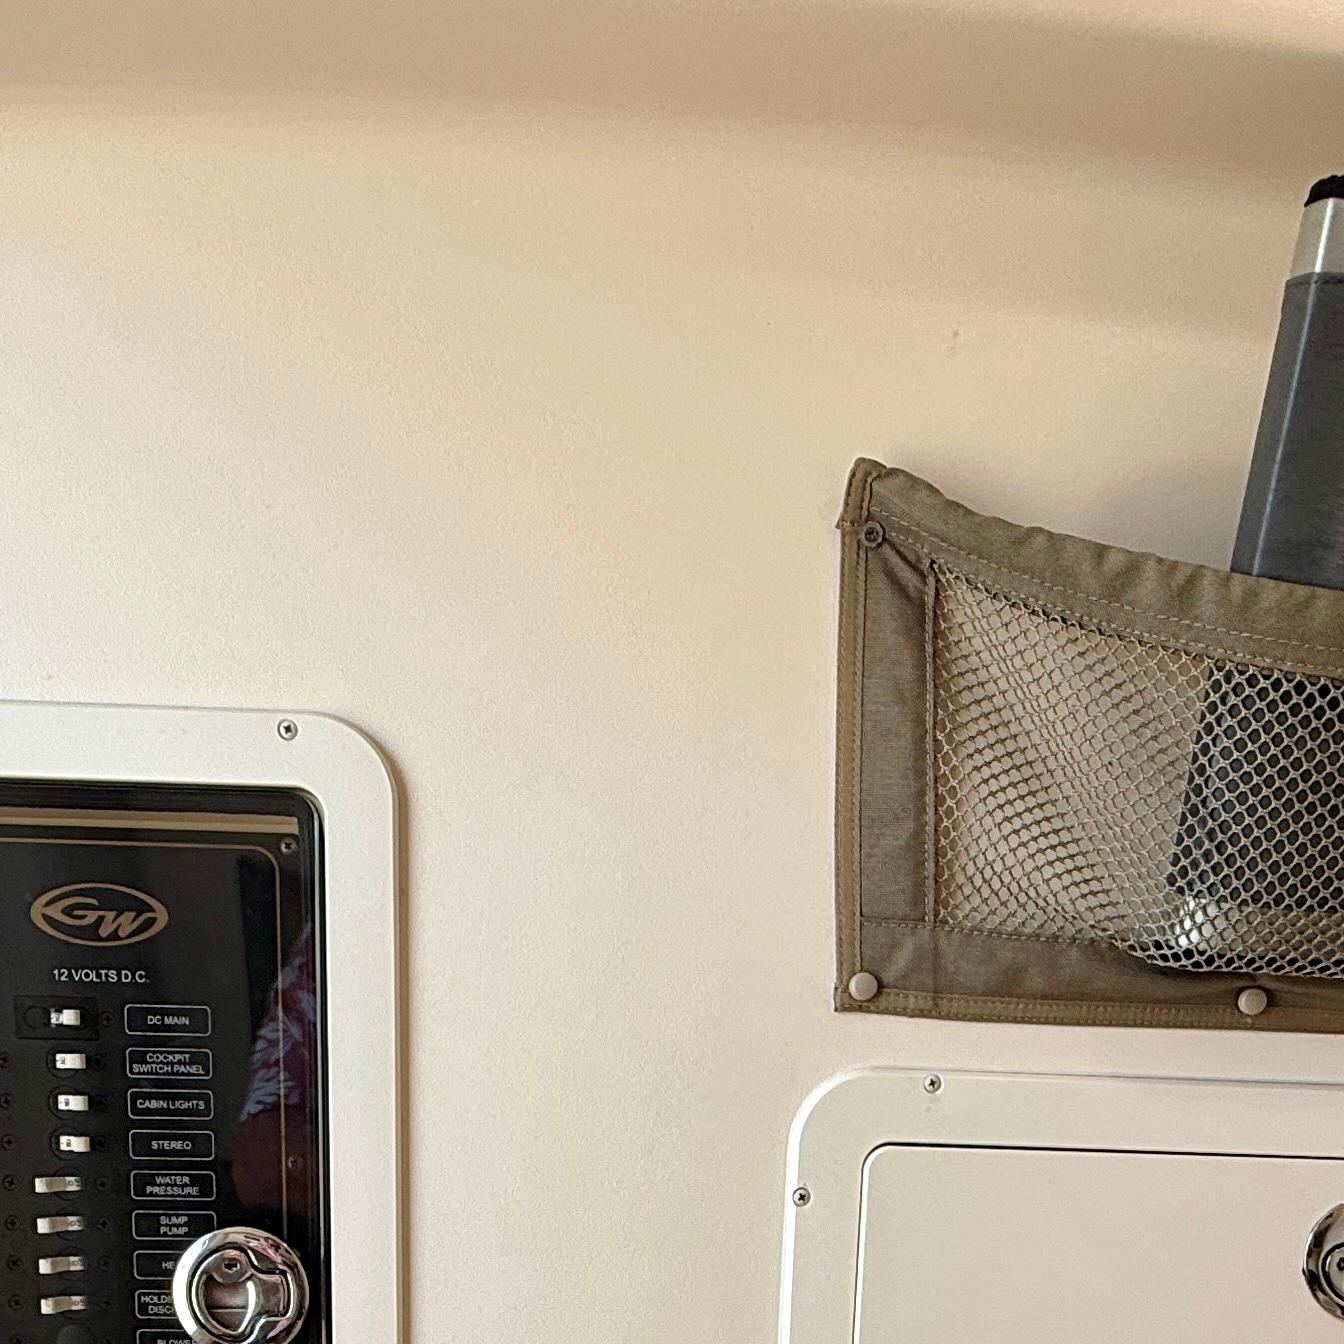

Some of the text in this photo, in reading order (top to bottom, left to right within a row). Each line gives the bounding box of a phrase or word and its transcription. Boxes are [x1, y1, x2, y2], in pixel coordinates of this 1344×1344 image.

[40, 895, 156, 938] GW
[53, 968, 150, 983] 12 VOLTS D.C.
[147, 1015, 190, 1026] DC MAIN
[146, 1052, 190, 1062] COCKPIT
[132, 1063, 205, 1074] SWITCH PANEL
[136, 1099, 205, 1110] CABIN LIGHTS
[151, 1140, 192, 1150] STEREO
[155, 1175, 190, 1185] WATER
[146, 1185, 200, 1195] PRESSURE
[159, 1215, 188, 1225] SUMP
[160, 1226, 189, 1235] PUMP
[161, 1260, 175, 1270] HE
